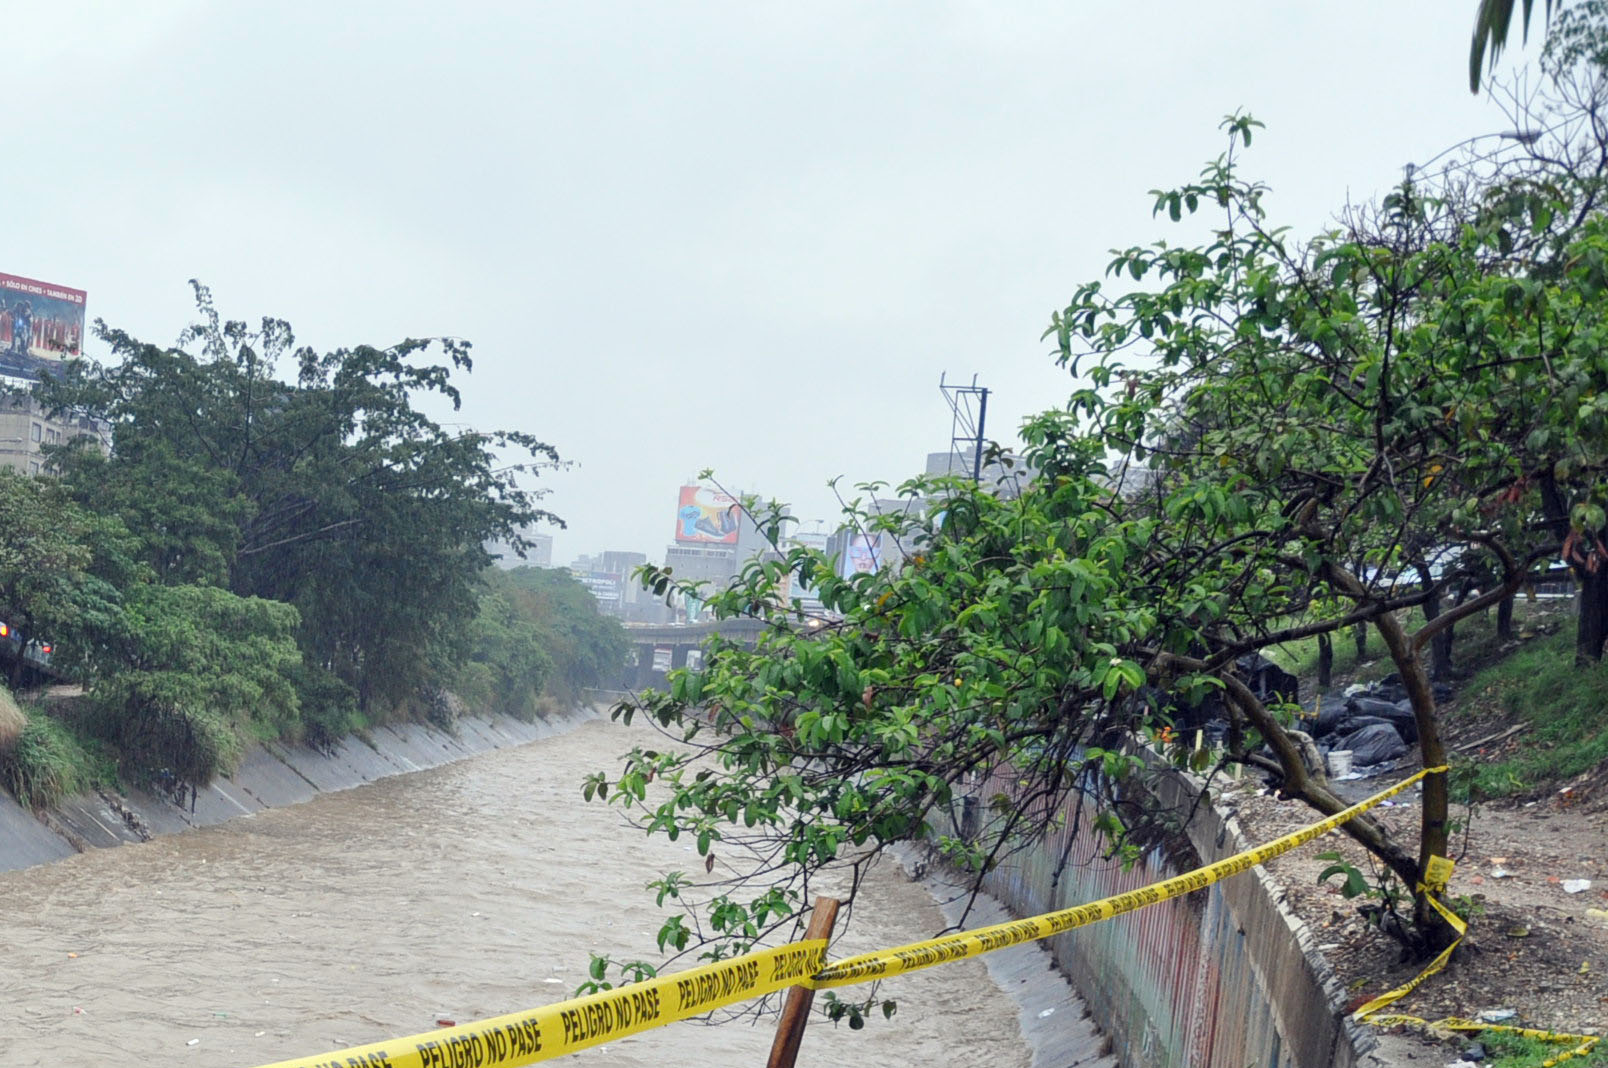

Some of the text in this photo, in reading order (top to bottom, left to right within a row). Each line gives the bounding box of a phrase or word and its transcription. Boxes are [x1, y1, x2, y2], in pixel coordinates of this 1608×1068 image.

[677, 961, 759, 1012] PELIGRO NO PASE
[482, 1028, 507, 1066] NO
[506, 1018, 542, 1059] PASE
[560, 988, 660, 1045] PELIGRO NO PASE
